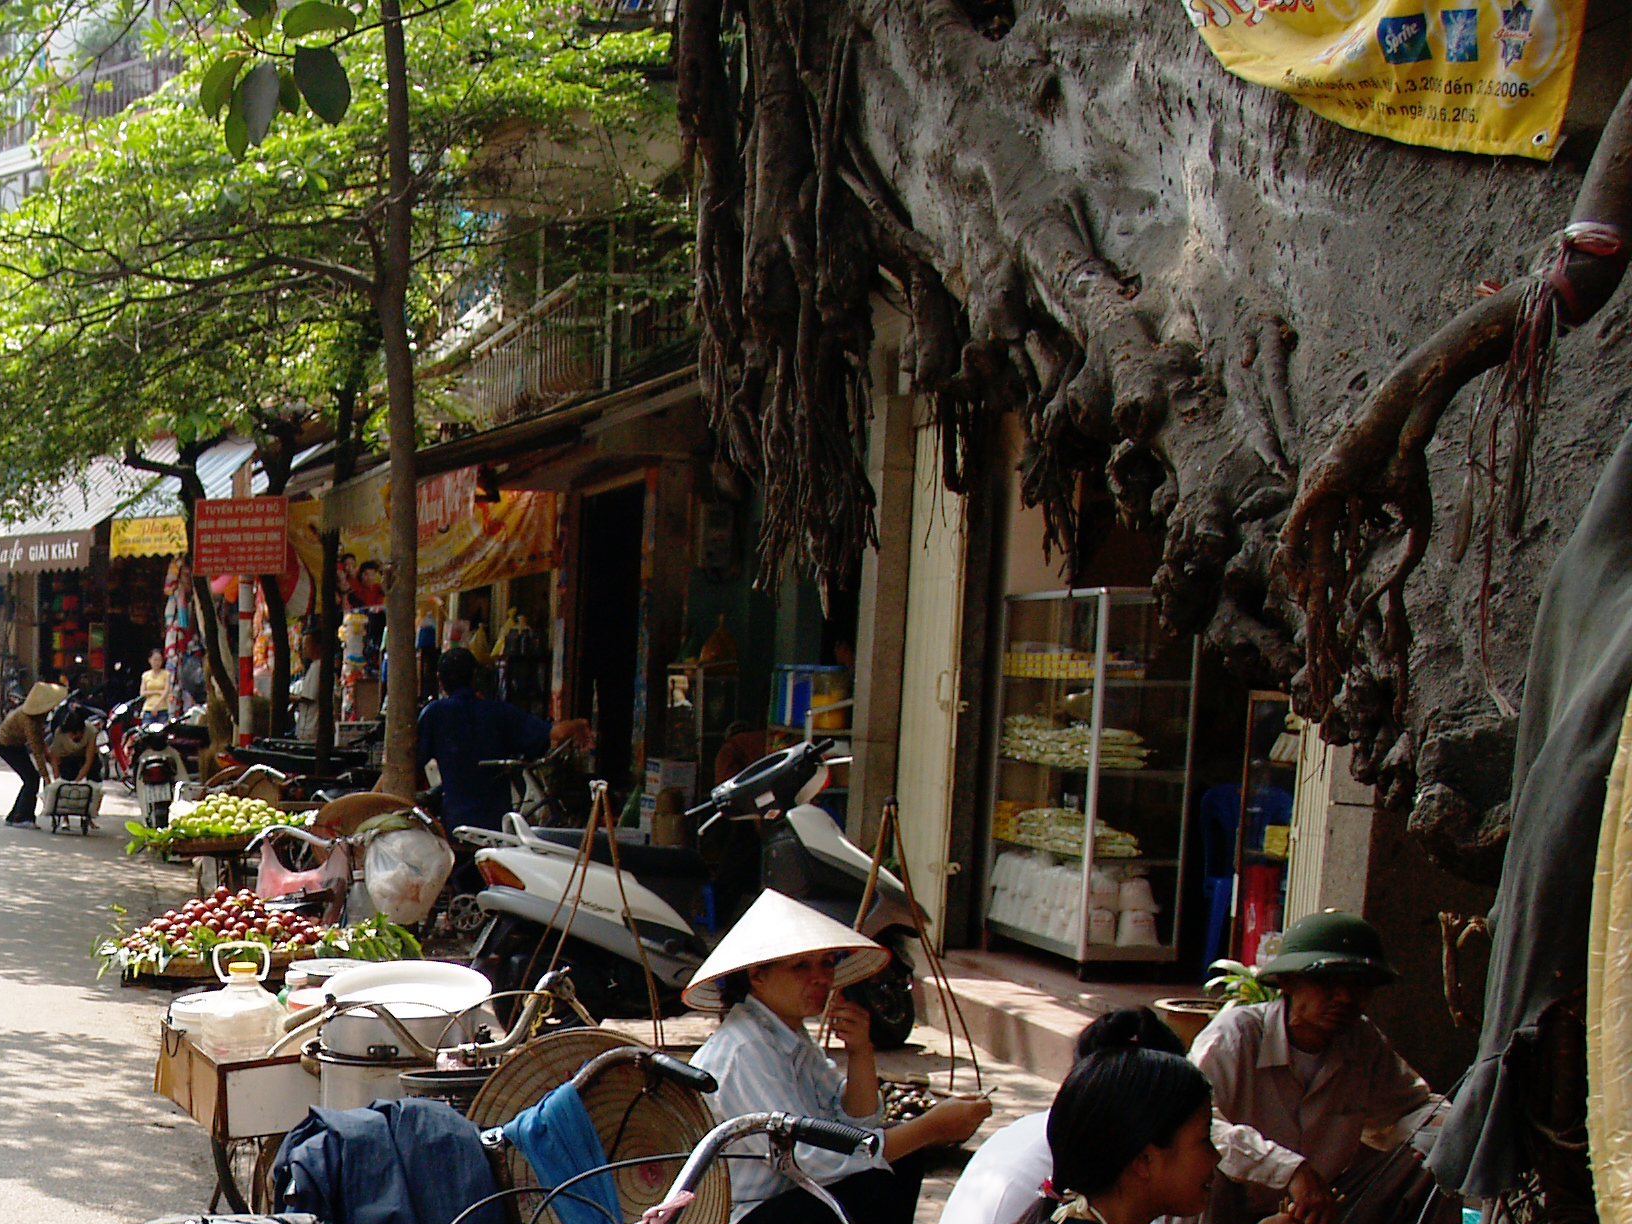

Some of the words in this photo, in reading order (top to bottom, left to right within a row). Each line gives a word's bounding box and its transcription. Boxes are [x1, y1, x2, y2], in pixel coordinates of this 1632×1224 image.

[1385, 21, 1420, 54] Sprite
[1444, 77, 1473, 95] đến
[29, 540, 49, 562] GIẢI
[51, 538, 79, 560] KHÁT
